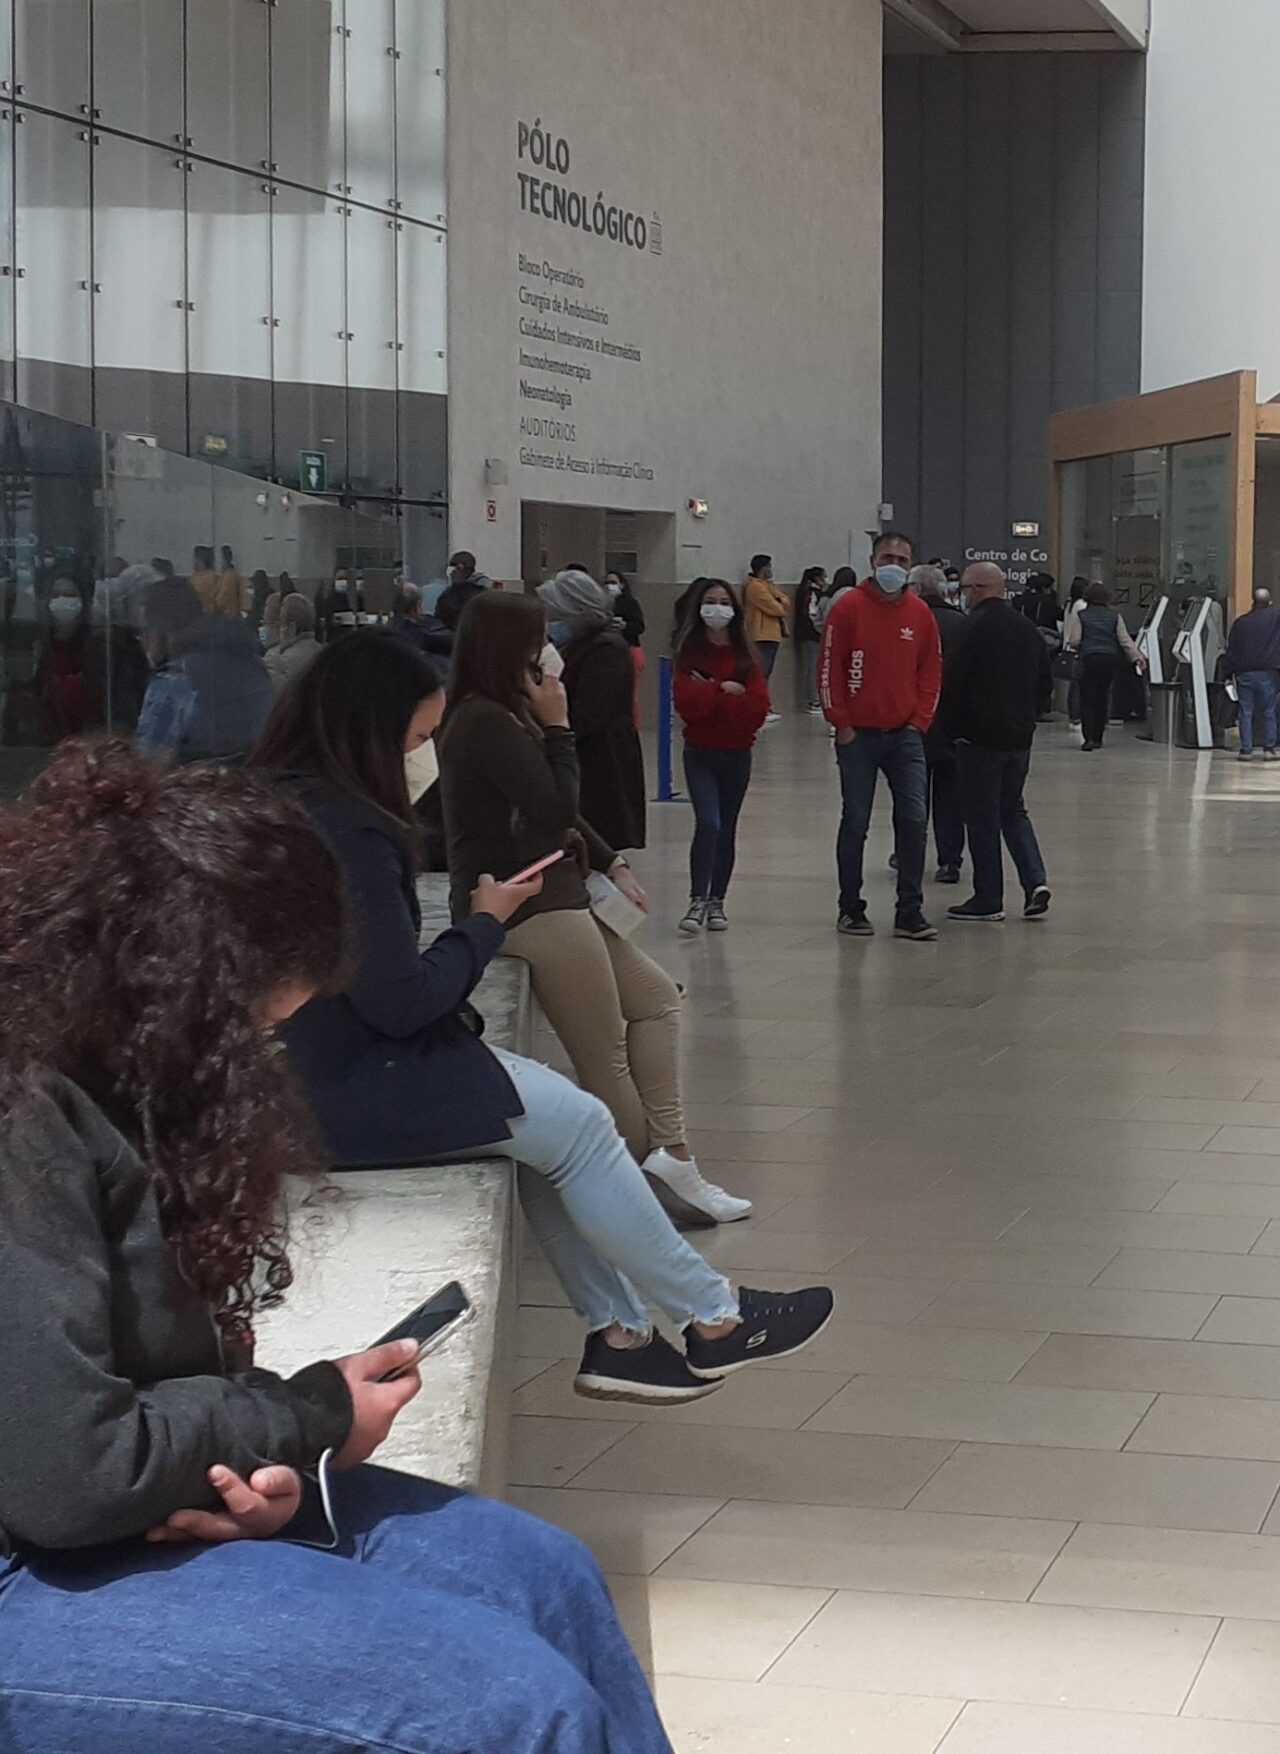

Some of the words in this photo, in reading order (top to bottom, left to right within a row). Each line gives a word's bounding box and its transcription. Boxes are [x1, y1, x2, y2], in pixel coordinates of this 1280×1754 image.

[517, 117, 570, 175] PÓLO
[517, 172, 647, 250] TECNOLÓGICO
[518, 253, 541, 277] Bloco
[519, 316, 556, 342] Cuidados
[557, 326, 595, 351] Intensivos
[519, 379, 572, 410] Neonatologia
[965, 547, 1007, 561] Centro
[1011, 549, 1027, 561] de
